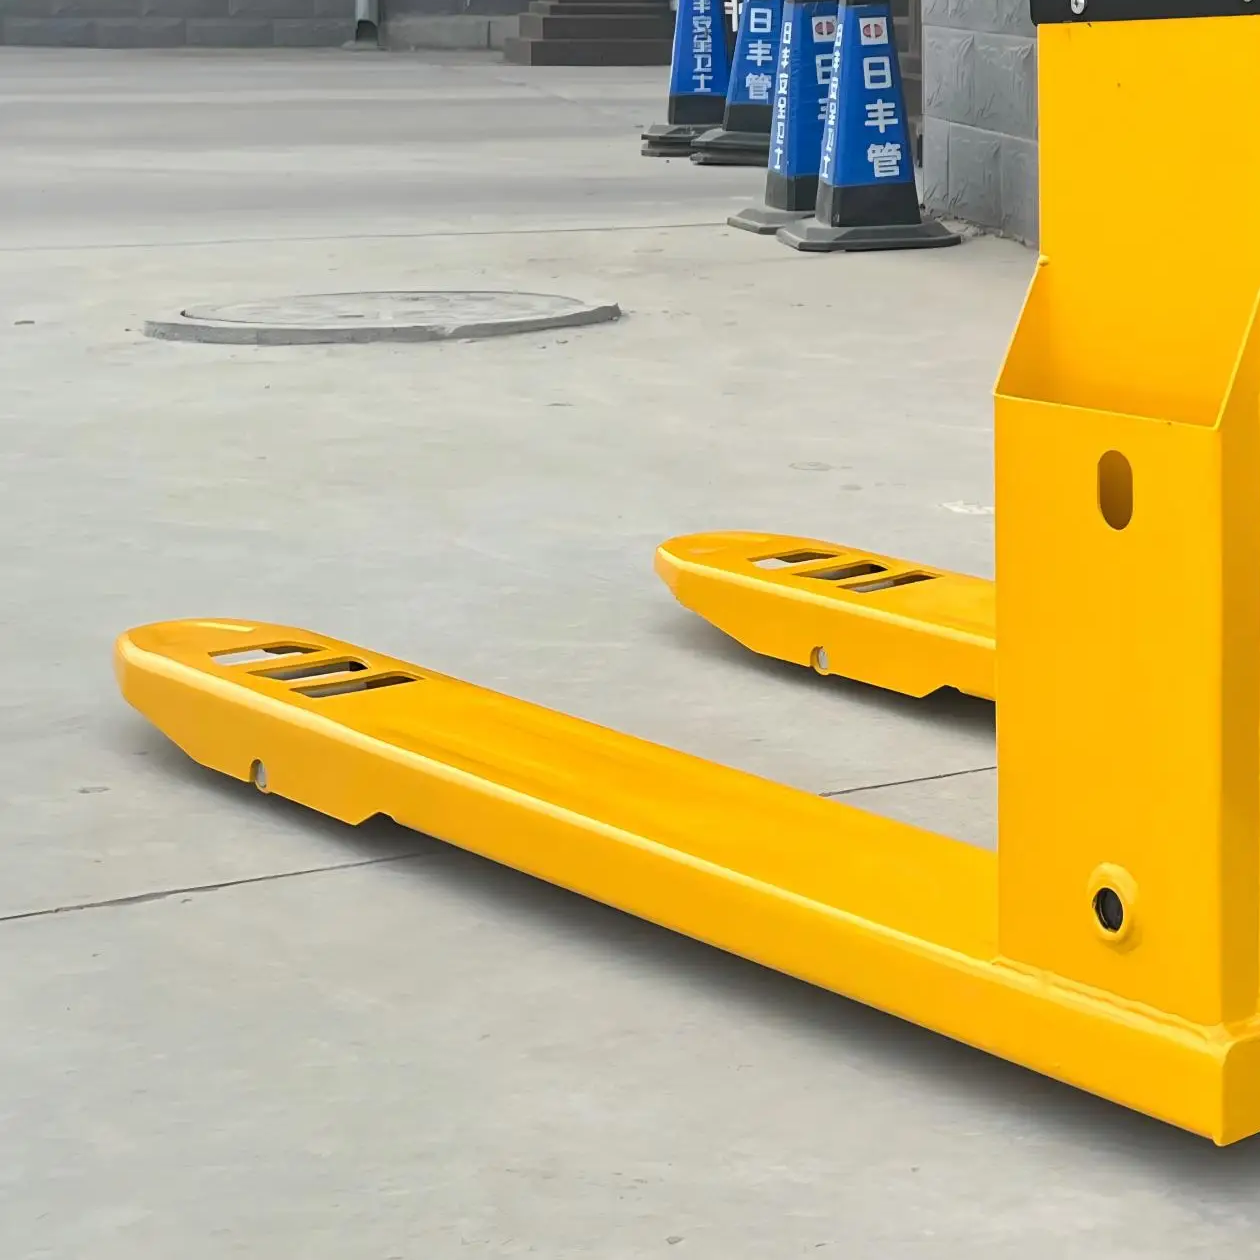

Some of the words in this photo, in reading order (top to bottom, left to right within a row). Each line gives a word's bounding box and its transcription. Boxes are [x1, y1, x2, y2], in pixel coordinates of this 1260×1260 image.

[746, 7, 773, 100] 日丰管
[863, 56, 902, 178] 日丰管
